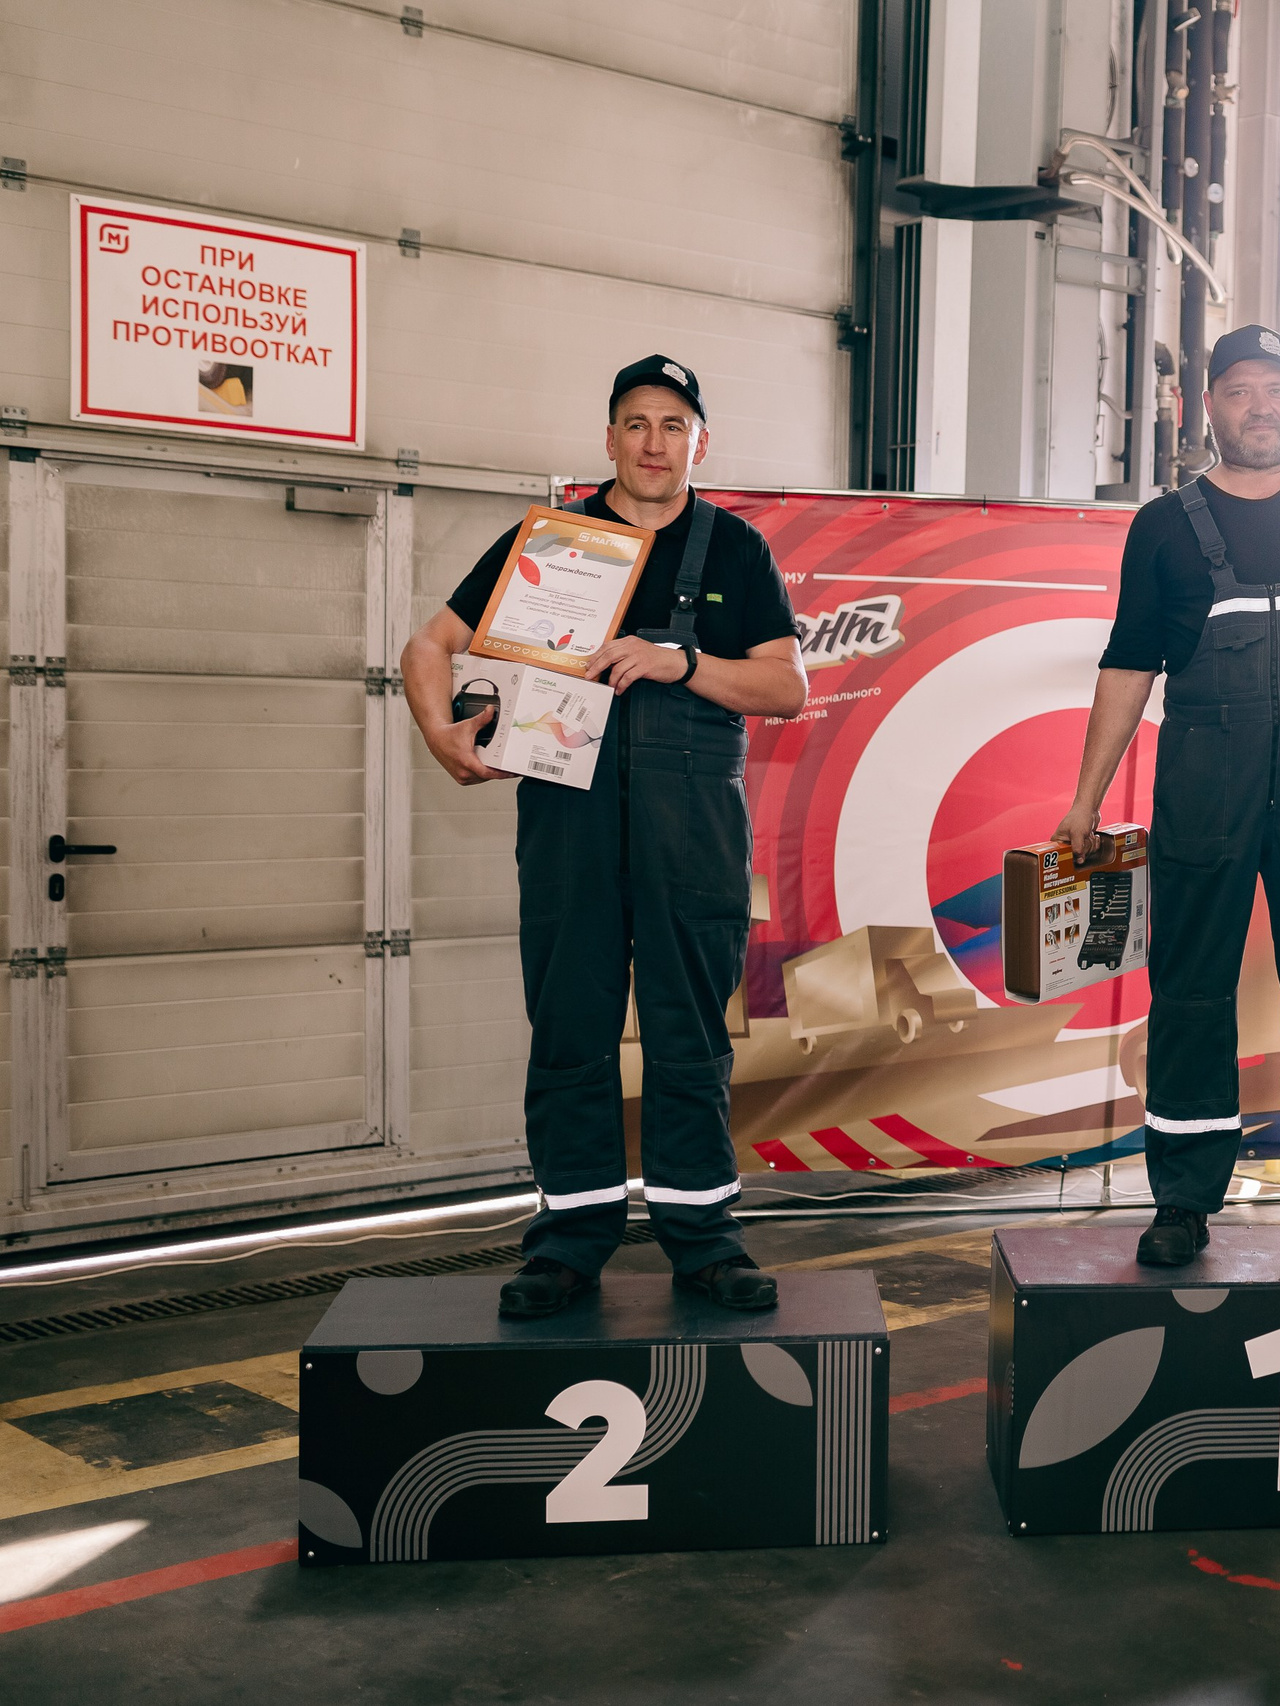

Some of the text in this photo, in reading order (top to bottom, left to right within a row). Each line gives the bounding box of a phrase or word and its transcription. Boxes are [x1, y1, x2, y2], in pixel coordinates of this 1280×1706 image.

[200, 244, 255, 272] ПРИ
[141, 265, 308, 309] ОСТАНОВКЕ
[141, 294, 308, 337] ИСПОЛЬЗУЙ
[112, 319, 333, 368] ПРОТИВООТКАТ
[590, 536, 630, 550] МАГНИТ
[545, 562, 602, 579] Награждается
[783, 572, 807, 584] МУ
[534, 677, 557, 687] DIGMA
[804, 687, 881, 707] сионального
[1043, 851, 1059, 869] 82
[1044, 885, 1078, 899] PROFESSIONAL
[544, 1378, 649, 1524] 2
